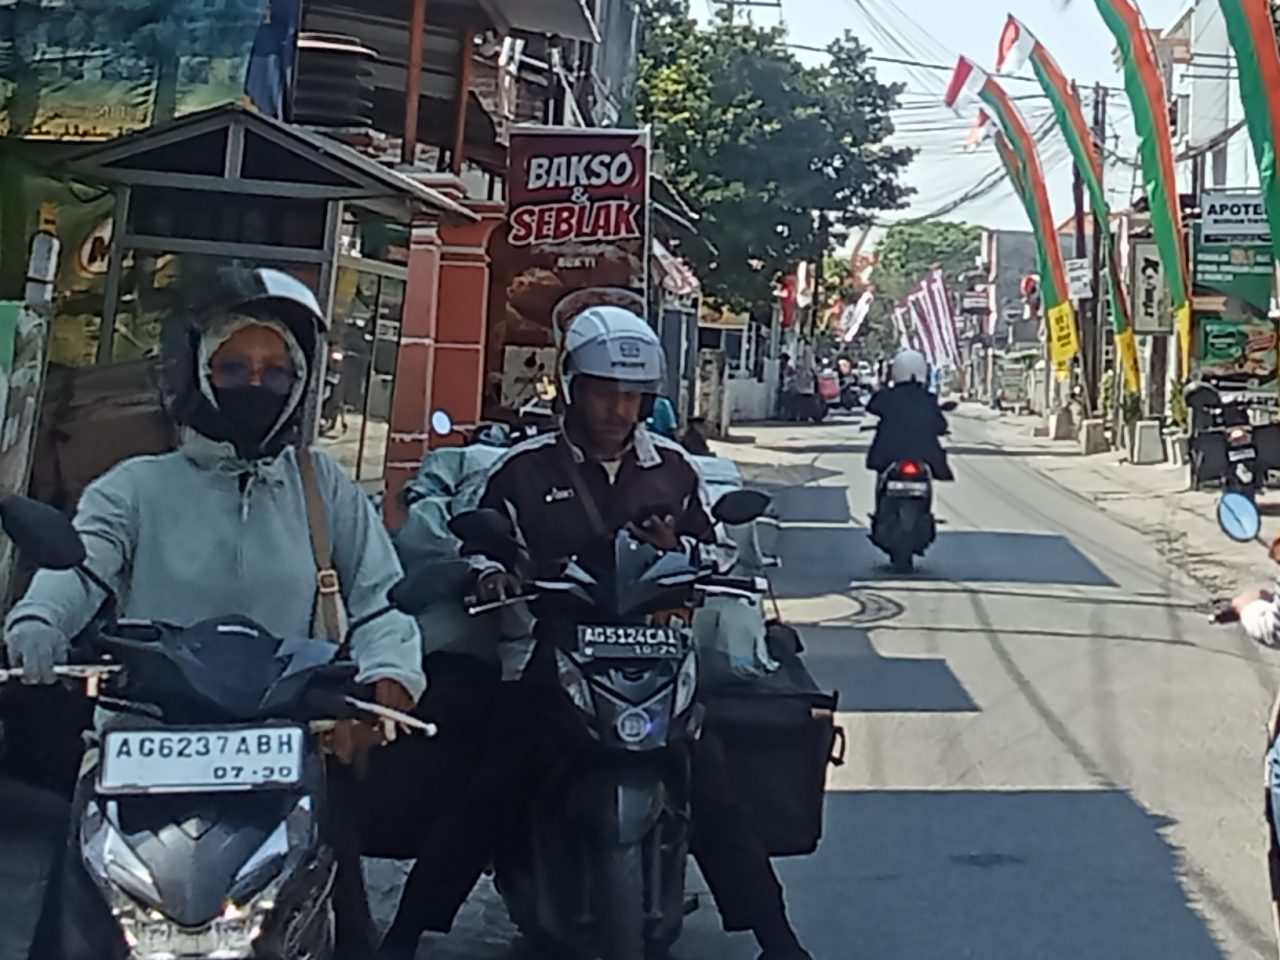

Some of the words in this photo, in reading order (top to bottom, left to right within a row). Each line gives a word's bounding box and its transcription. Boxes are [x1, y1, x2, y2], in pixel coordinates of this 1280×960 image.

[527, 152, 633, 190] BAKSO
[571, 187, 588, 202] &
[508, 200, 641, 245] SEBLAK
[1207, 203, 1268, 216] APOTE
[116, 733, 293, 759] AG6237ABH
